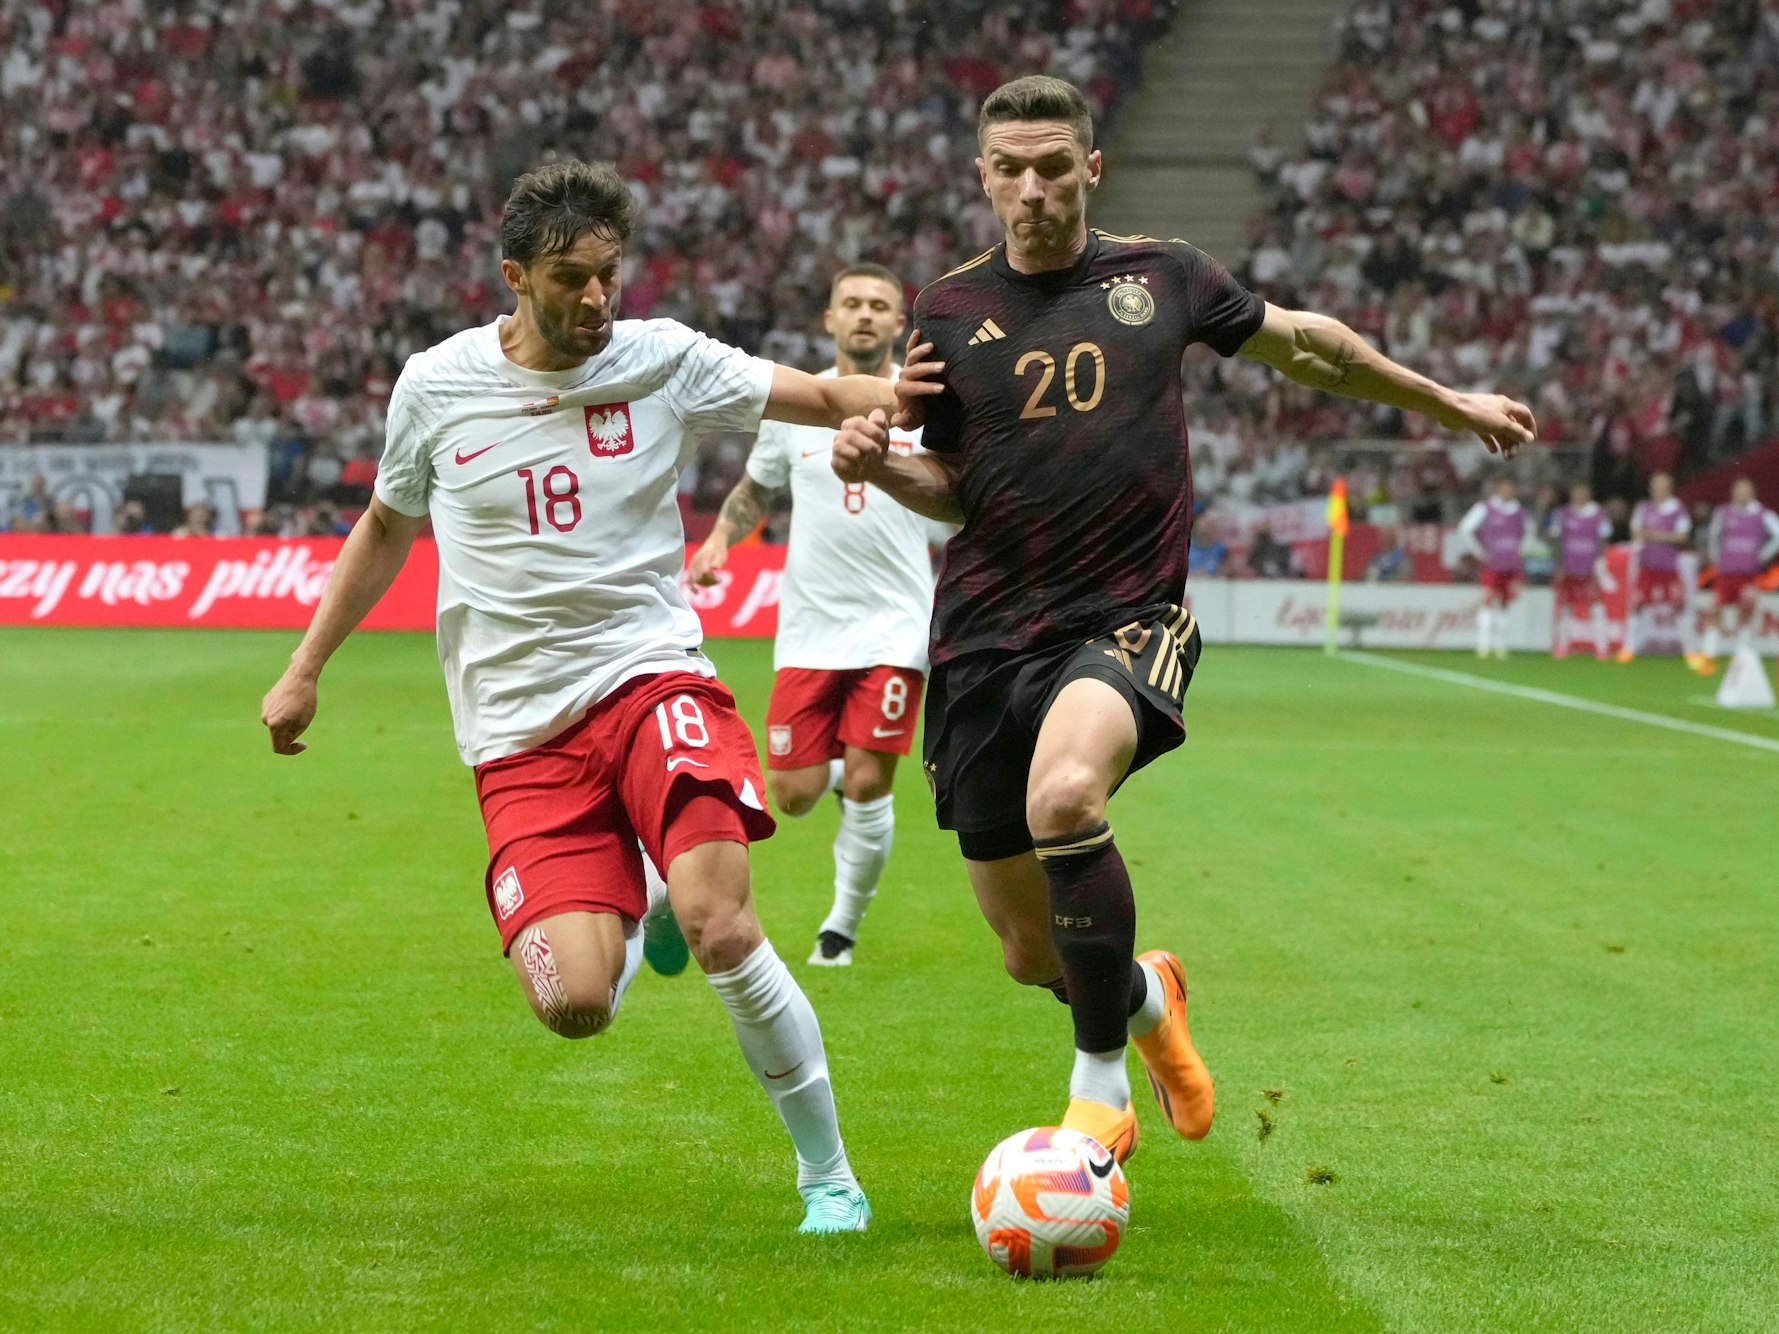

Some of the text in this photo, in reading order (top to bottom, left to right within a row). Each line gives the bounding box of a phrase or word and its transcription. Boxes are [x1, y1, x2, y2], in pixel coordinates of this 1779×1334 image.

[1014, 342, 1106, 420] 20
[517, 465, 582, 535] 18
[843, 480, 866, 516] 8
[0, 559, 78, 618] zy
[78, 560, 190, 606] nas
[655, 694, 709, 750] 18
[881, 676, 907, 721] 8
